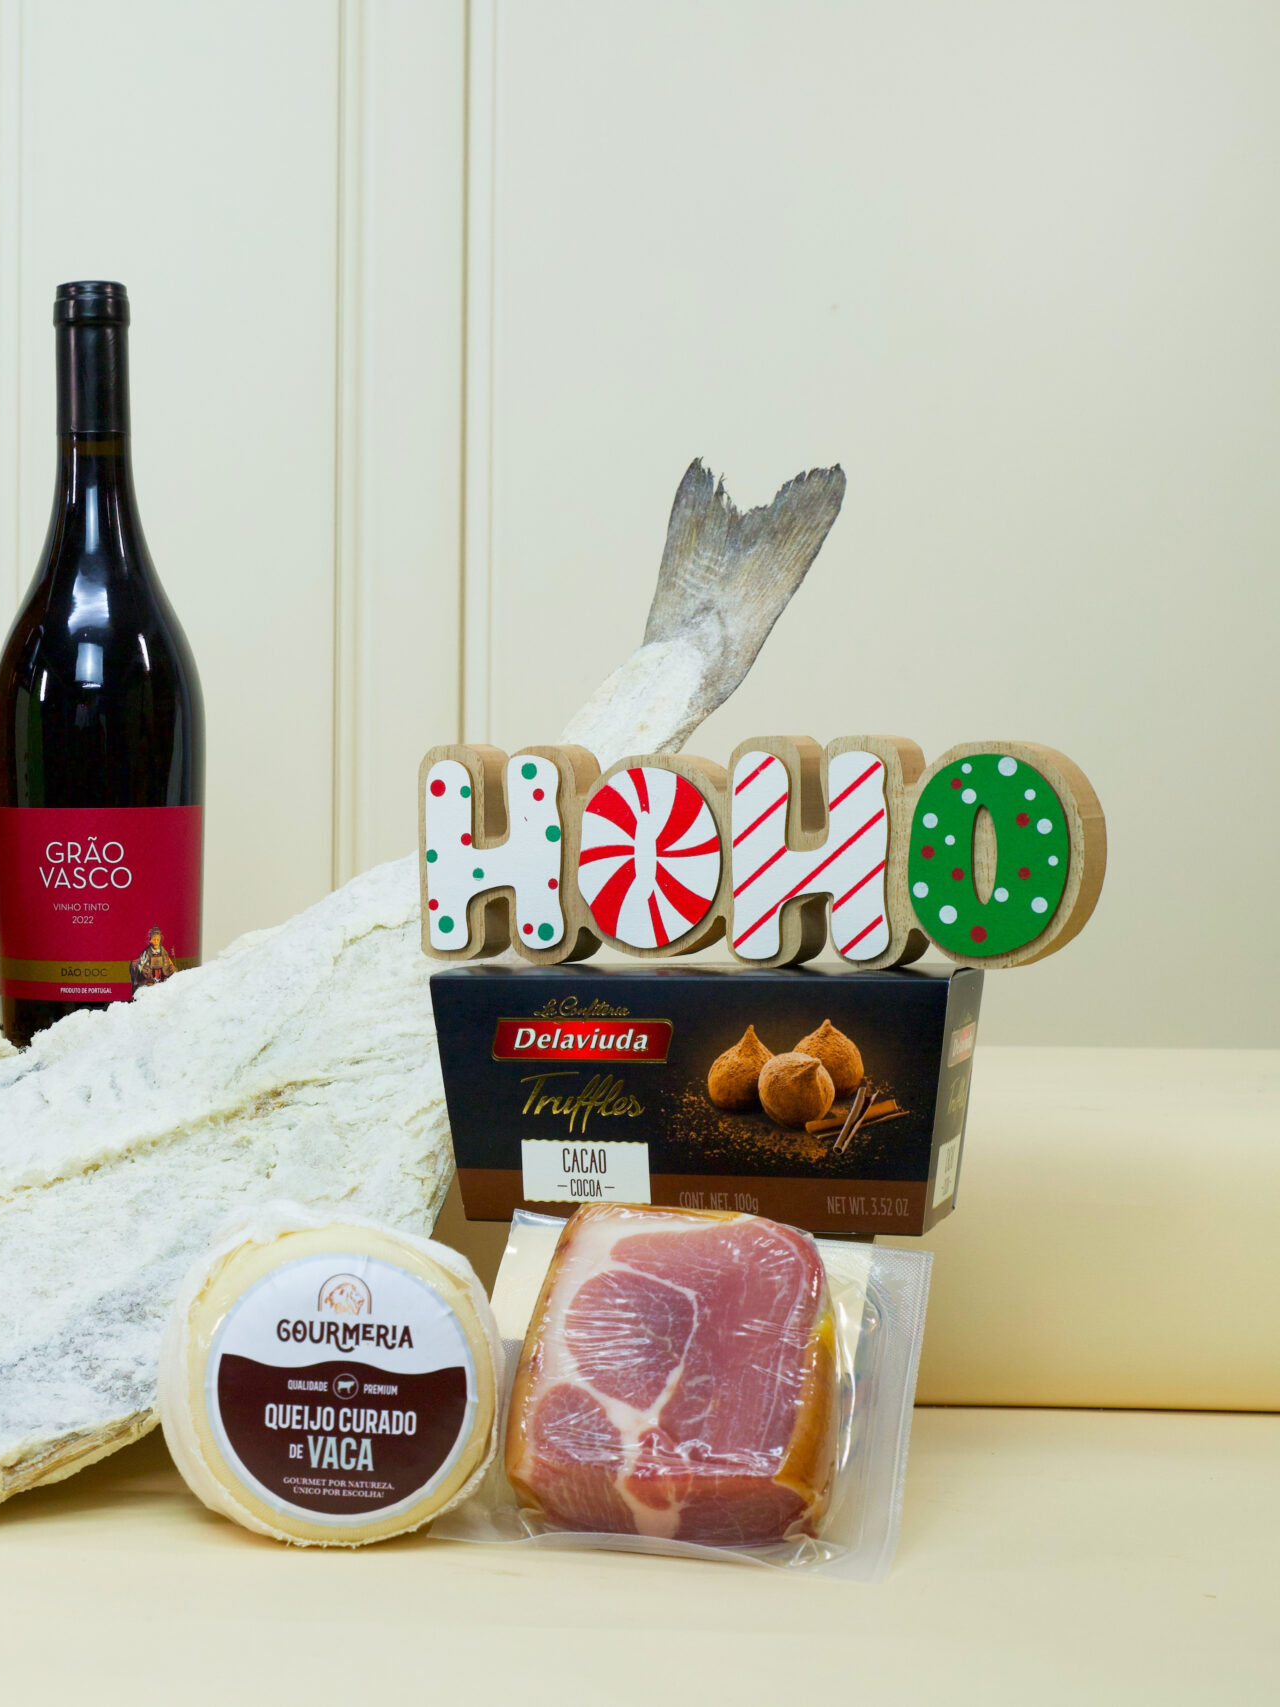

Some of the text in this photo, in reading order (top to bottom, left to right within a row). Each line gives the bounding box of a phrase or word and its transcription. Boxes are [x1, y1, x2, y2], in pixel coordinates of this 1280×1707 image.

[46, 836, 124, 864] GRÃO
[39, 867, 132, 889] VASCO
[54, 903, 110, 912] VINHO TINTO
[73, 916, 94, 924] 2022
[61, 966, 108, 977] DÃO DOC
[514, 1028, 649, 1052] Delaviuda
[521, 1072, 646, 1134] Truffles
[562, 1148, 607, 1174] CACAO
[570, 1178, 603, 1197] COCOA
[679, 1192, 759, 1214] CONT. NET. 100g
[827, 1196, 910, 1217] NET WT. 3.52 OZ
[277, 1319, 414, 1353] GOURMERIA
[288, 1380, 399, 1396] QUALIDADE PREMIUM
[265, 1403, 417, 1436] QUEIJO CURADO
[289, 1435, 375, 1472] DE VACA
[283, 1477, 395, 1490] GOURMET POR NATUREZA,
[322, 1488, 341, 1496] POR
[342, 1490, 385, 1498] ESCOLHA!
